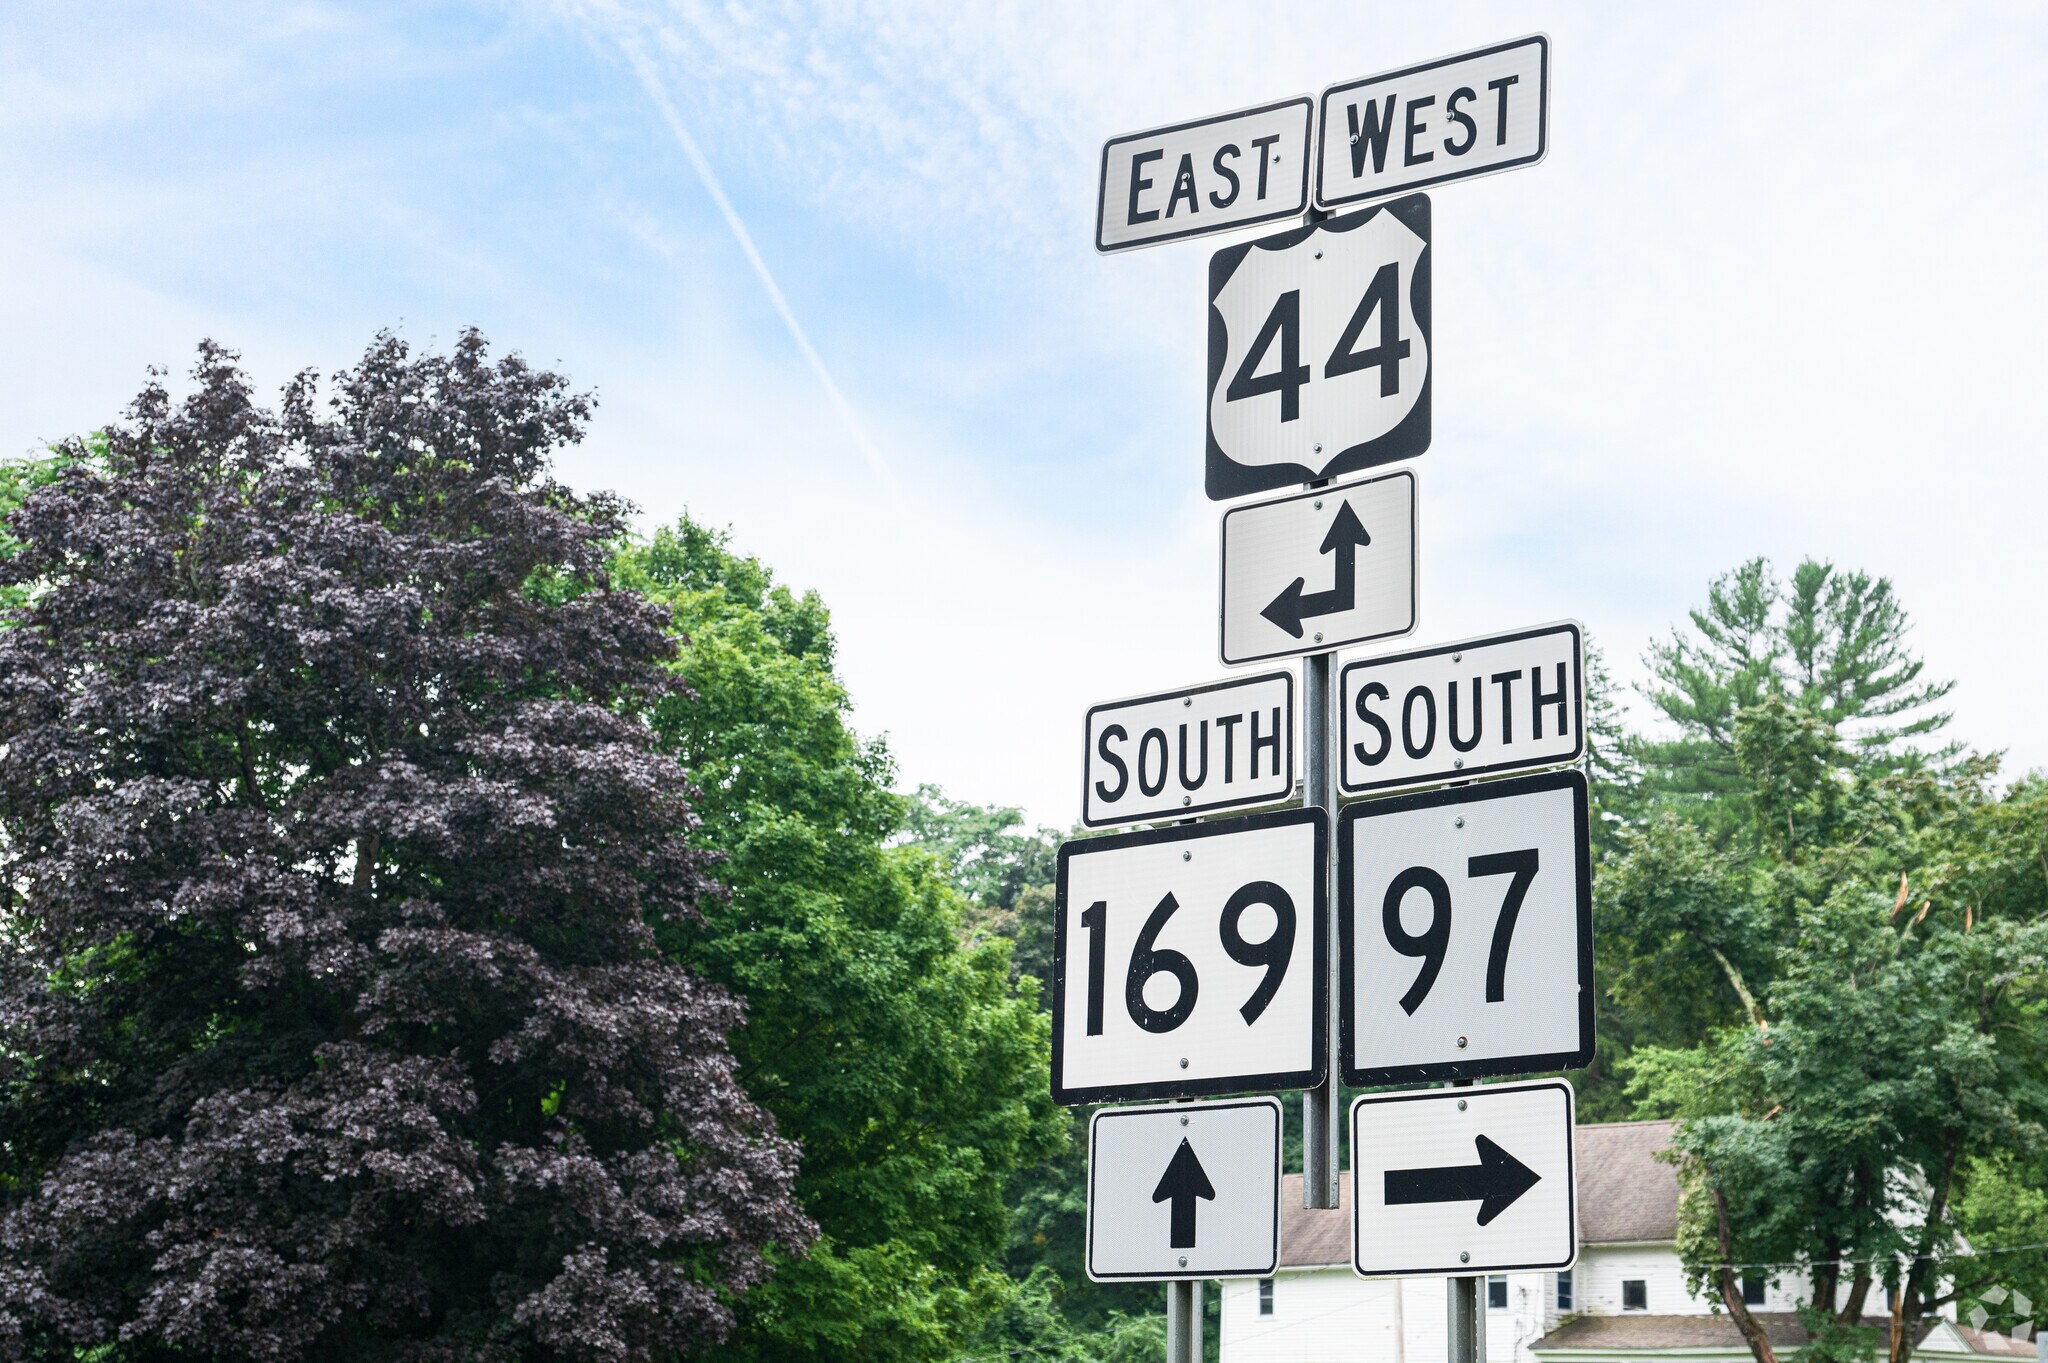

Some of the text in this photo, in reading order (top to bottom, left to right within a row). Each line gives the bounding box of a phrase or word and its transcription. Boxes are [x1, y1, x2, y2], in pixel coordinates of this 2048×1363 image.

[1127, 133, 1280, 226] EAST
[1346, 74, 1519, 179] WEST
[1226, 261, 1410, 424] 44
[1095, 706, 1281, 803] SOUTH
[1353, 661, 1568, 767] SOUTH
[1081, 880, 1297, 1036] 169
[1382, 847, 1539, 1017] 97
